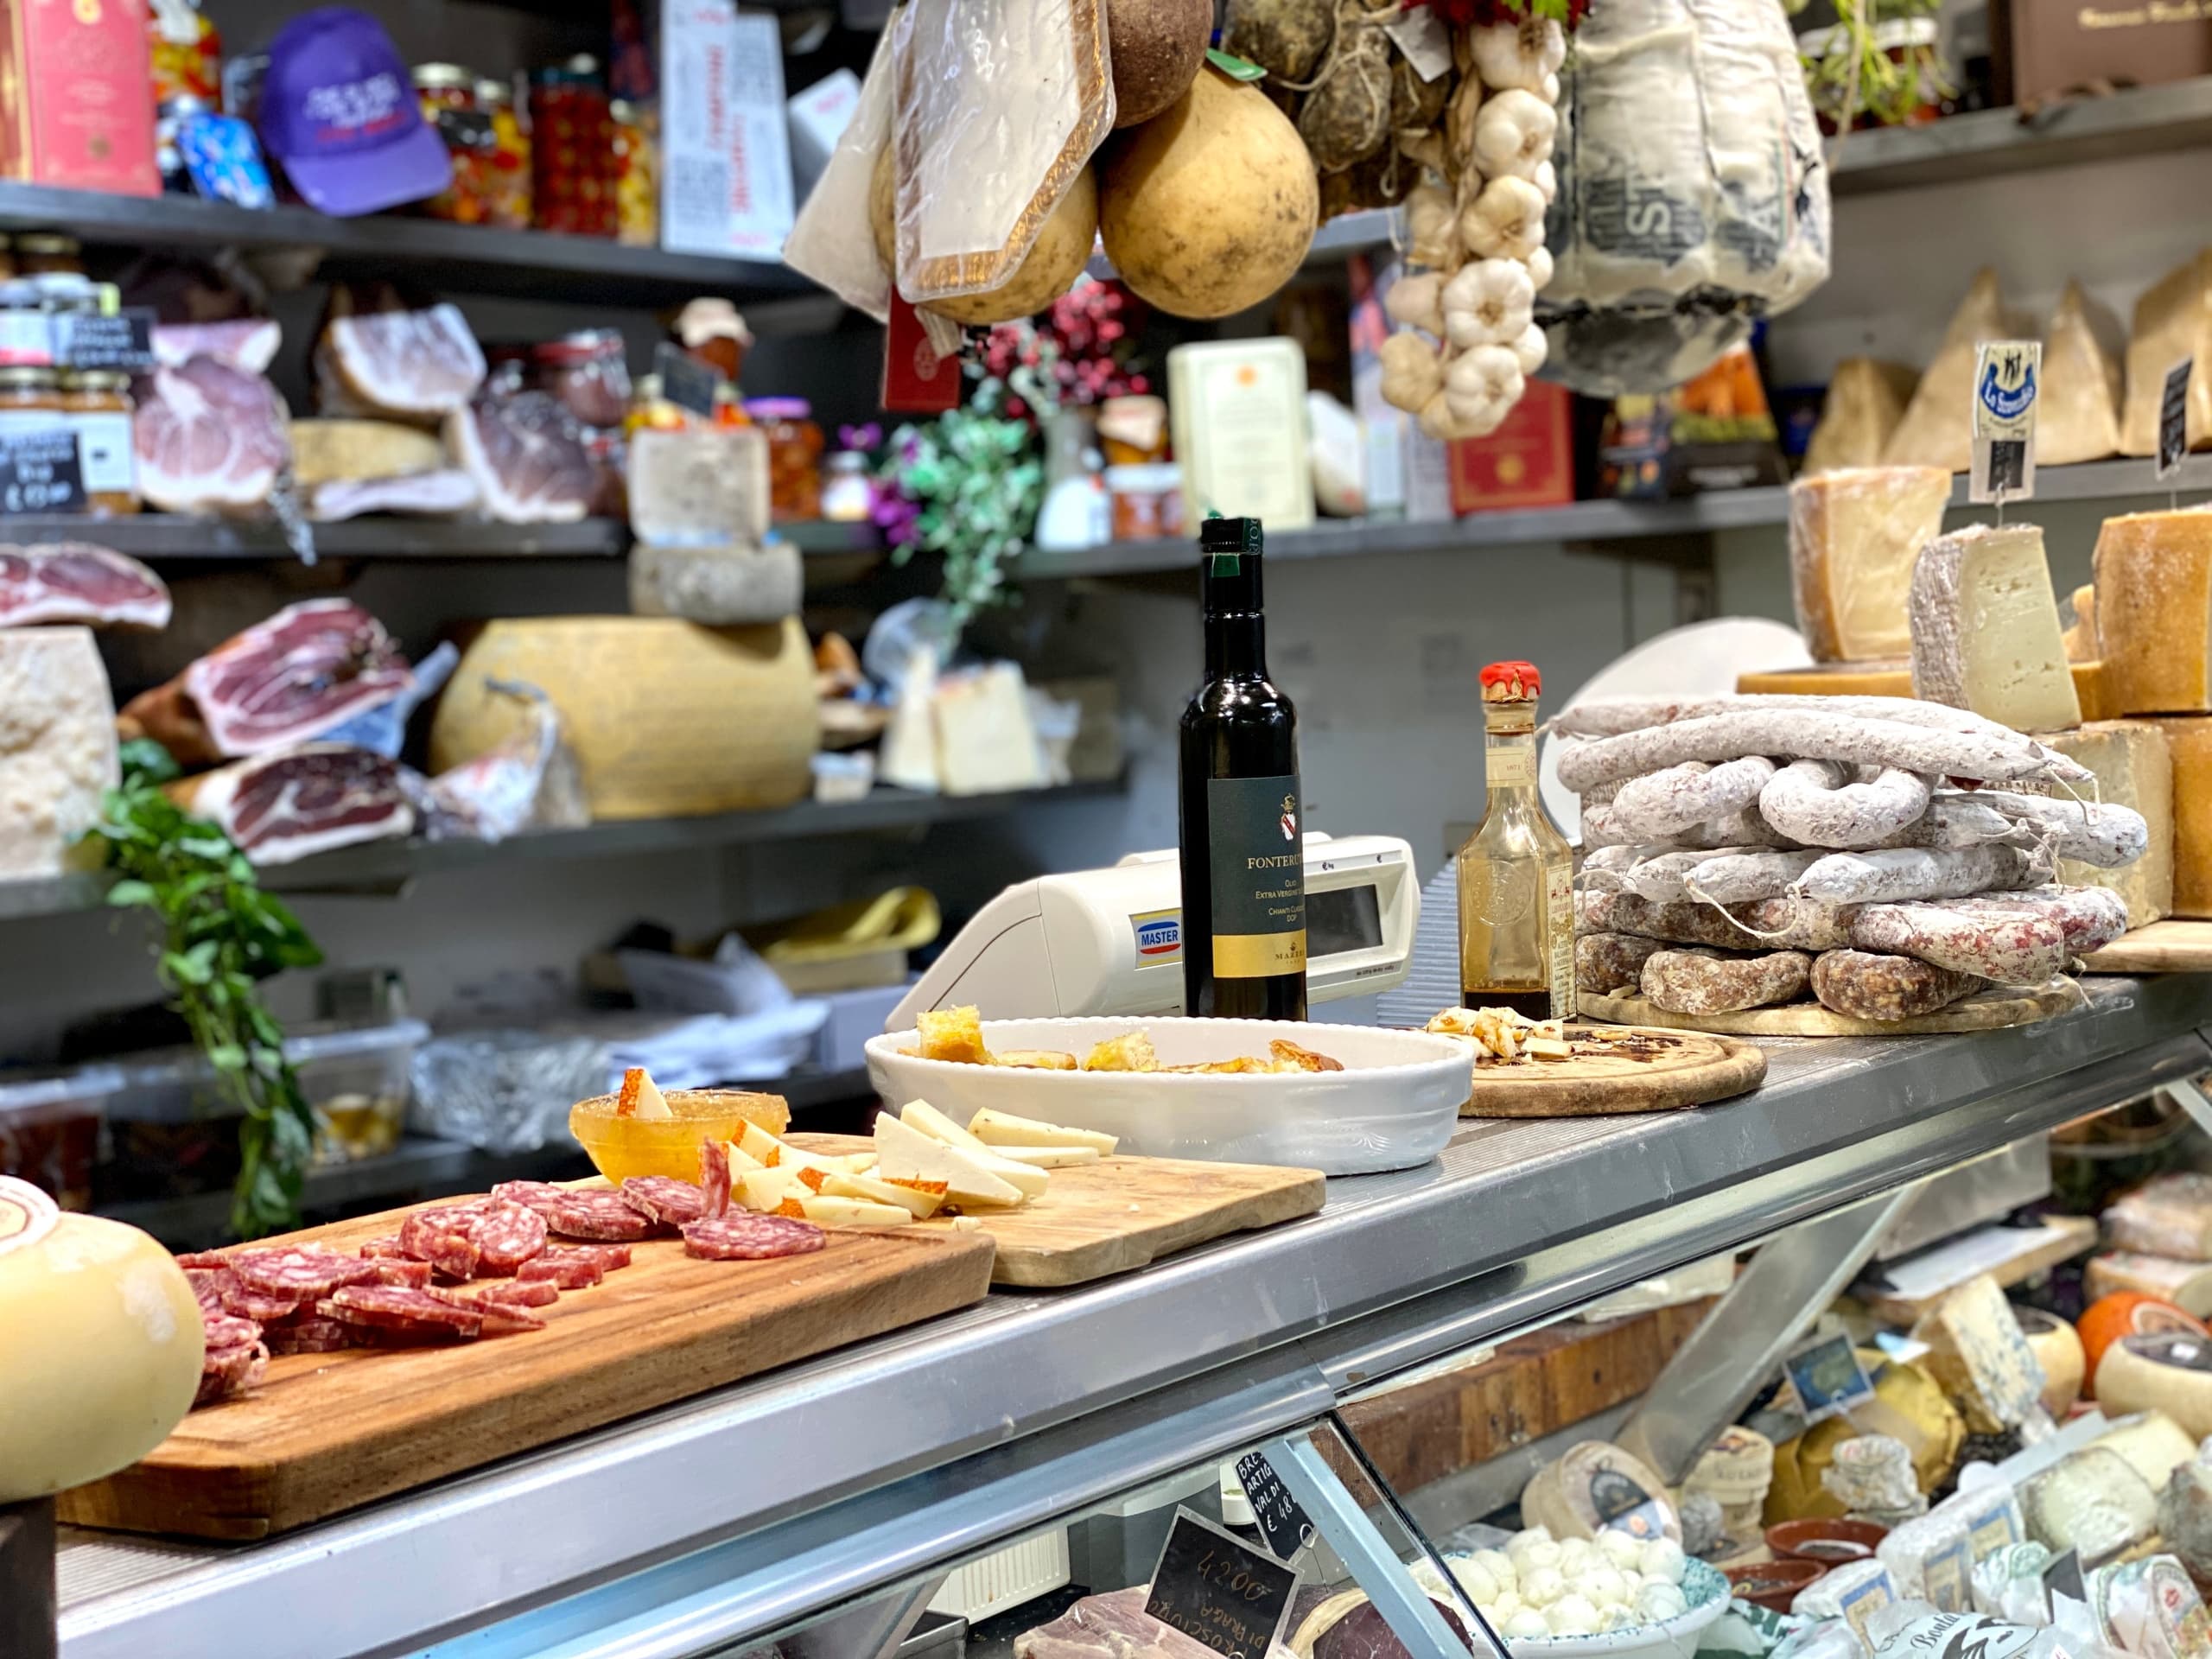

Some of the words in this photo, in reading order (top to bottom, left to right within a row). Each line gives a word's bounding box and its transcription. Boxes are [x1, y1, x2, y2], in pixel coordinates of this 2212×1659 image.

[1141, 930, 1179, 947] MASTER
[1237, 1453, 1263, 1480] BRE
[1255, 1491, 1272, 1515] VAL
[1270, 1481, 1281, 1497] DI
